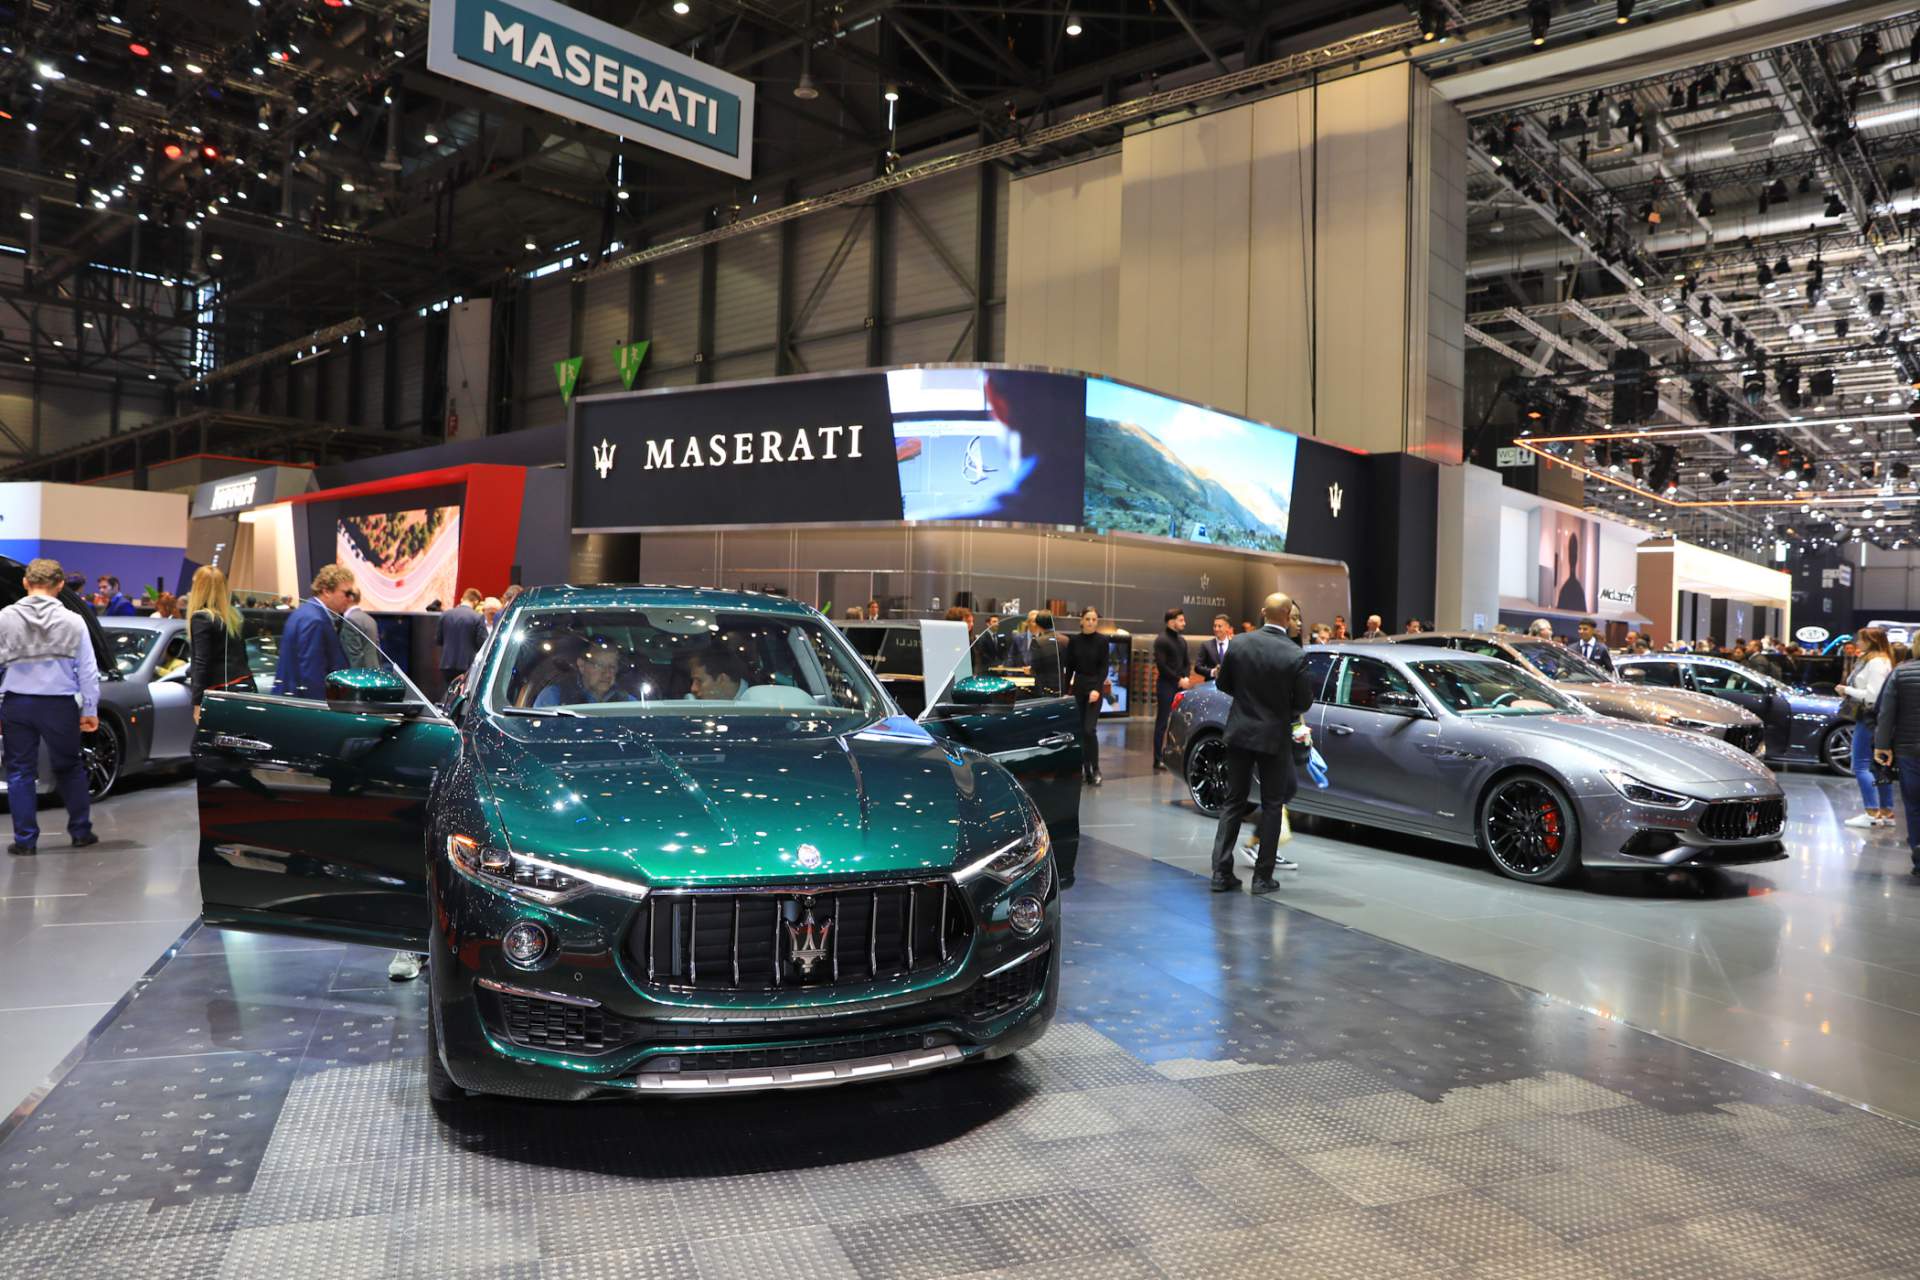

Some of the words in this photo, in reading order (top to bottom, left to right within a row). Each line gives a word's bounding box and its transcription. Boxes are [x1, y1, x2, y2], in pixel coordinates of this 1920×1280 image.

[483, 10, 718, 135] MASERATI
[643, 425, 863, 470] MASERATI
[1499, 450, 1515, 458] WC
